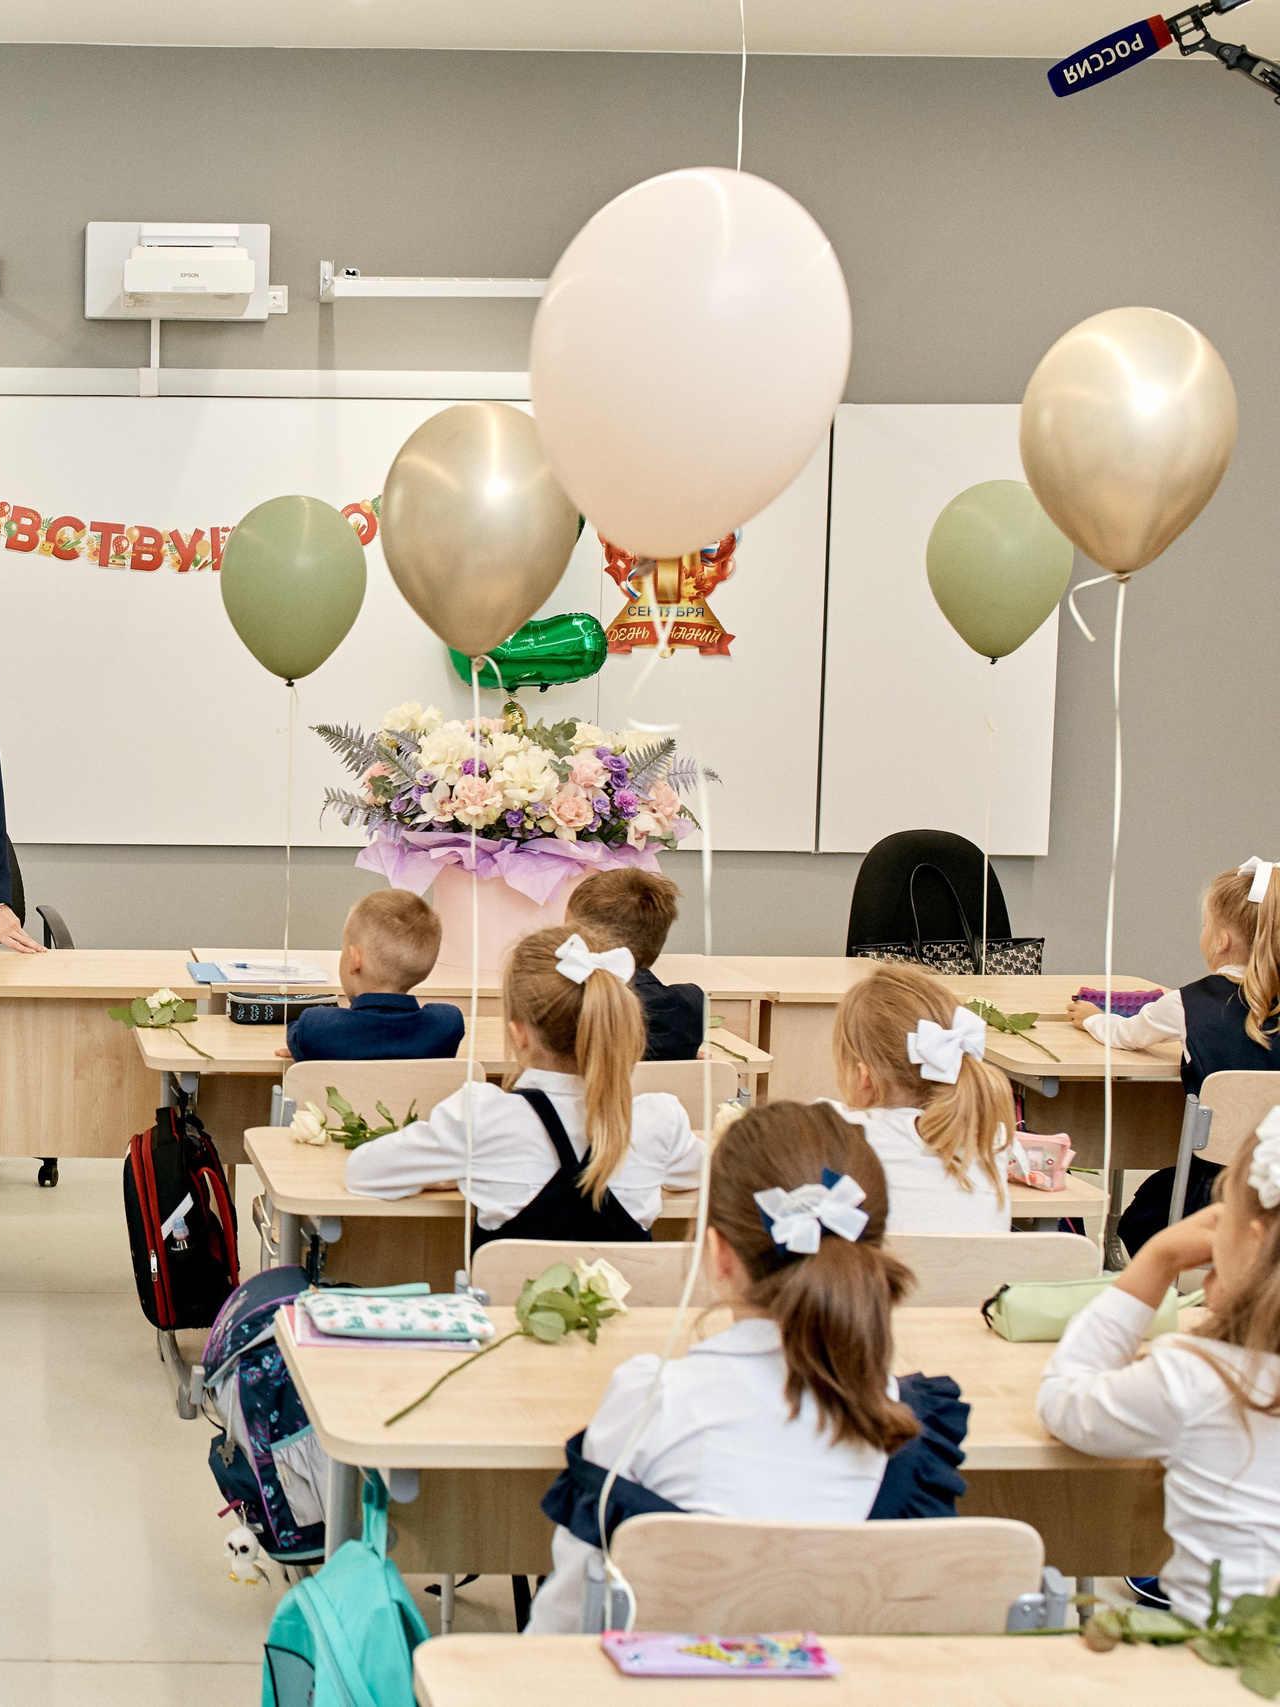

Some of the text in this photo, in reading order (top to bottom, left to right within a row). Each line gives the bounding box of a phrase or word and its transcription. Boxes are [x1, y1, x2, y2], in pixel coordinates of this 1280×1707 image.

[1062, 33, 1144, 85] РОССИЯ
[627, 606, 705, 617] СЕНТЯБРЯ
[607, 626, 722, 644] ДЕНЬ АНИЙ
